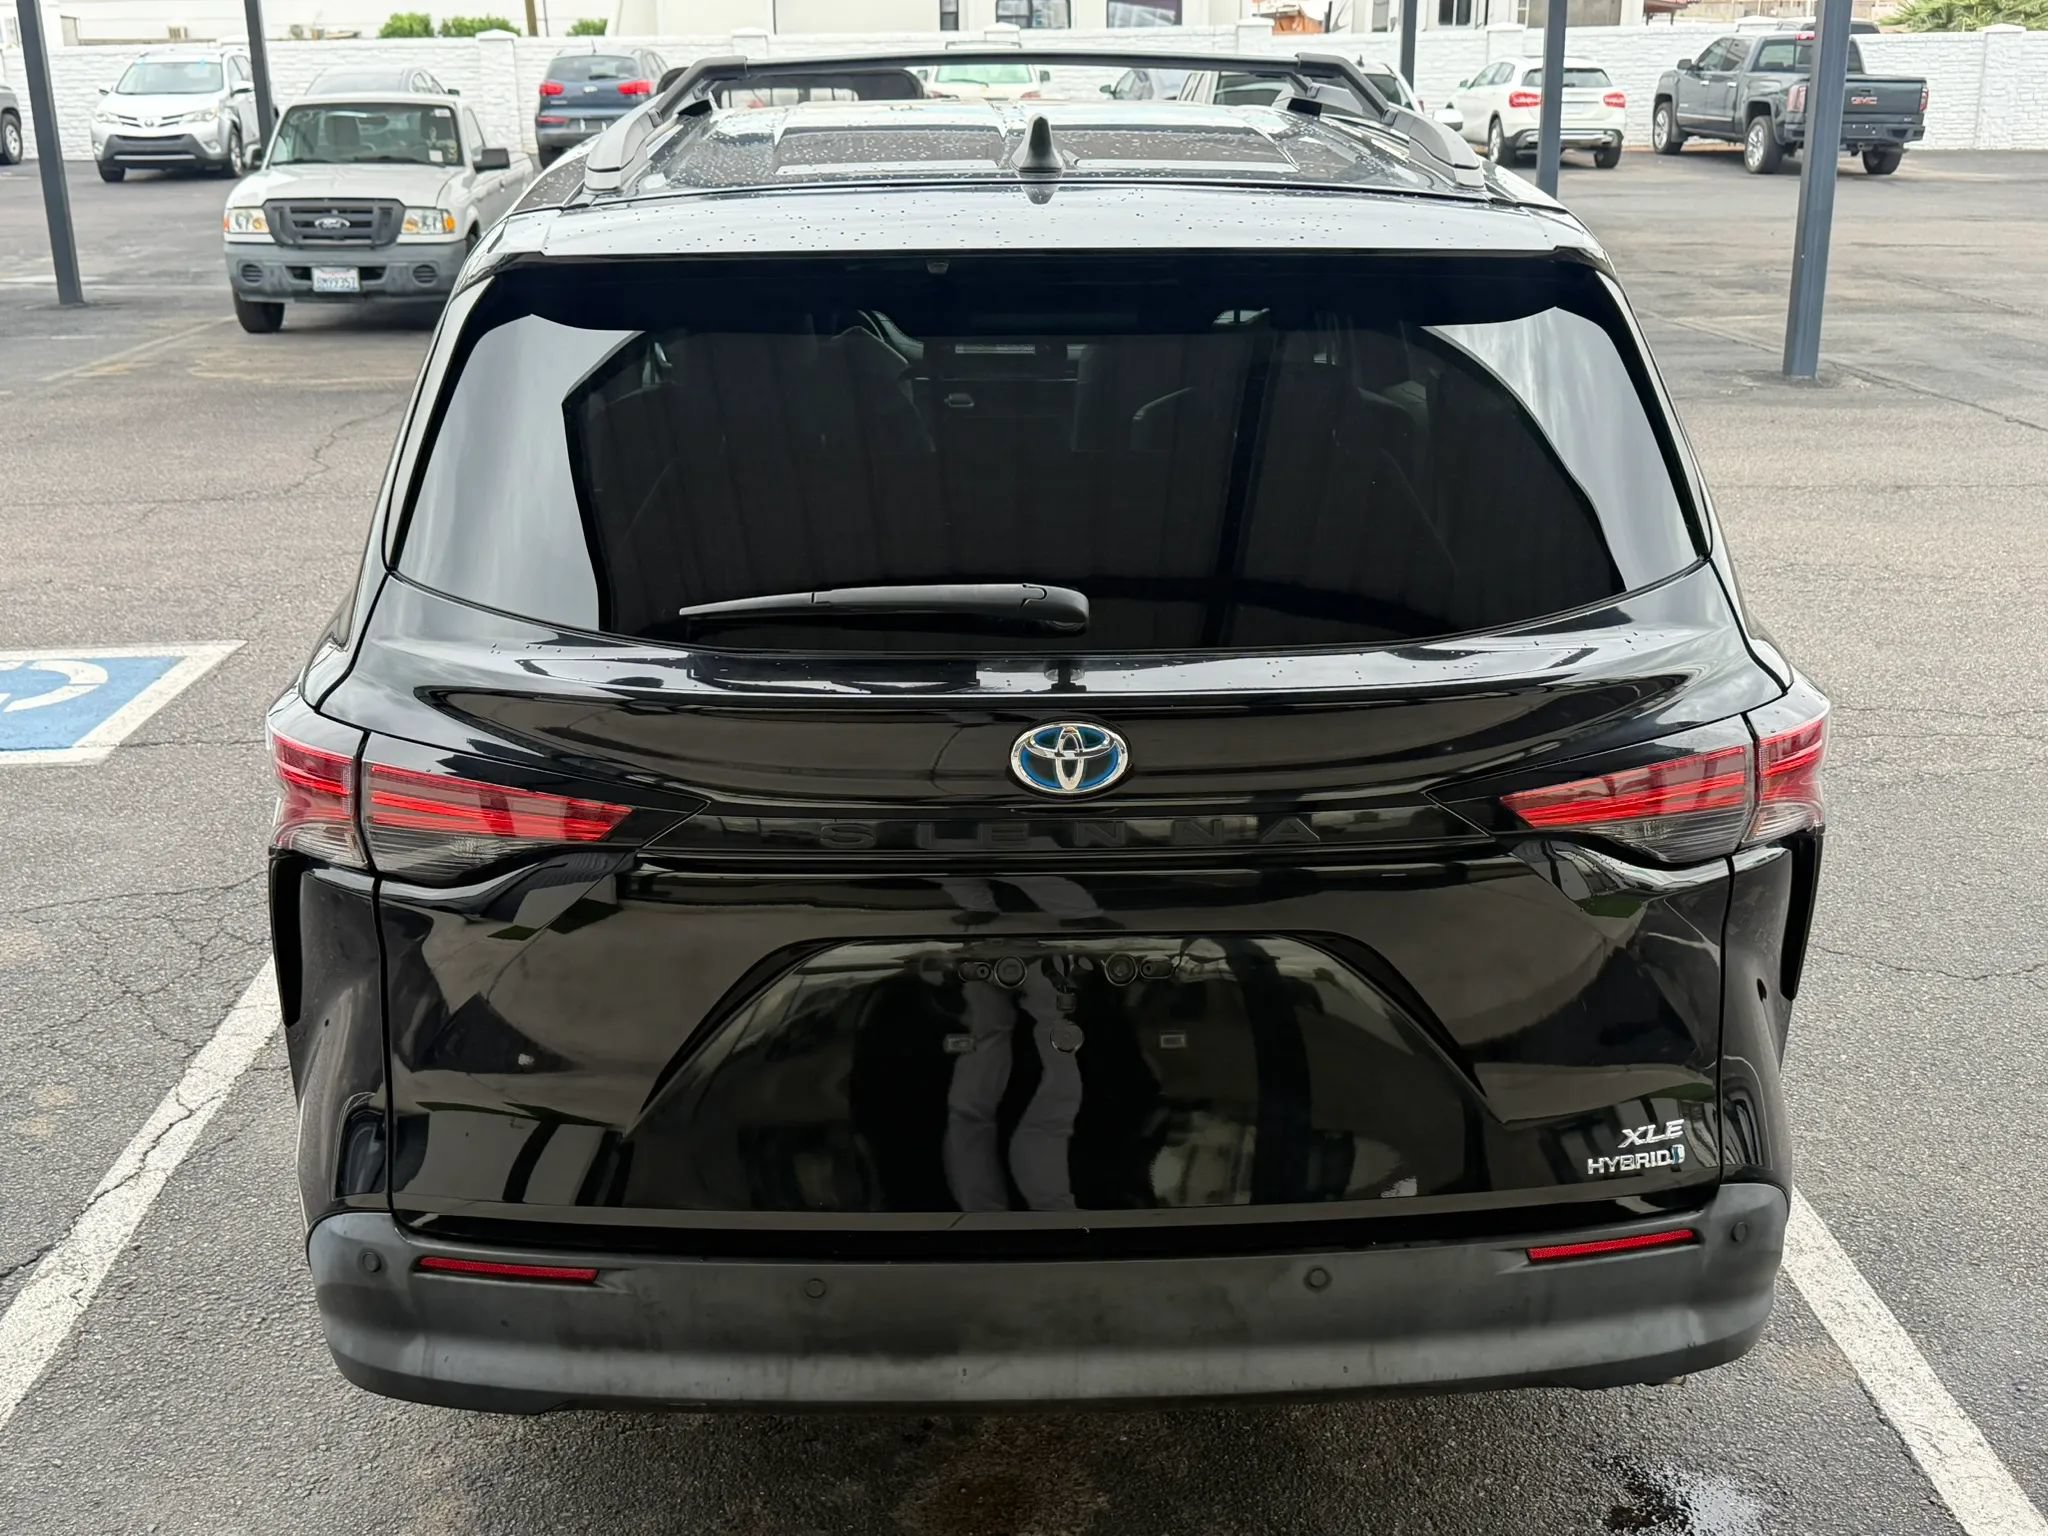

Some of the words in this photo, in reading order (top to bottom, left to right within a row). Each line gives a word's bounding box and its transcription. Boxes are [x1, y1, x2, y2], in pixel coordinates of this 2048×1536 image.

[1851, 96, 1877, 104] GMC
[819, 816, 1321, 849] SIENNA
[1618, 1118, 1684, 1148] XLE
[1587, 1148, 1673, 1175] HYBRID
